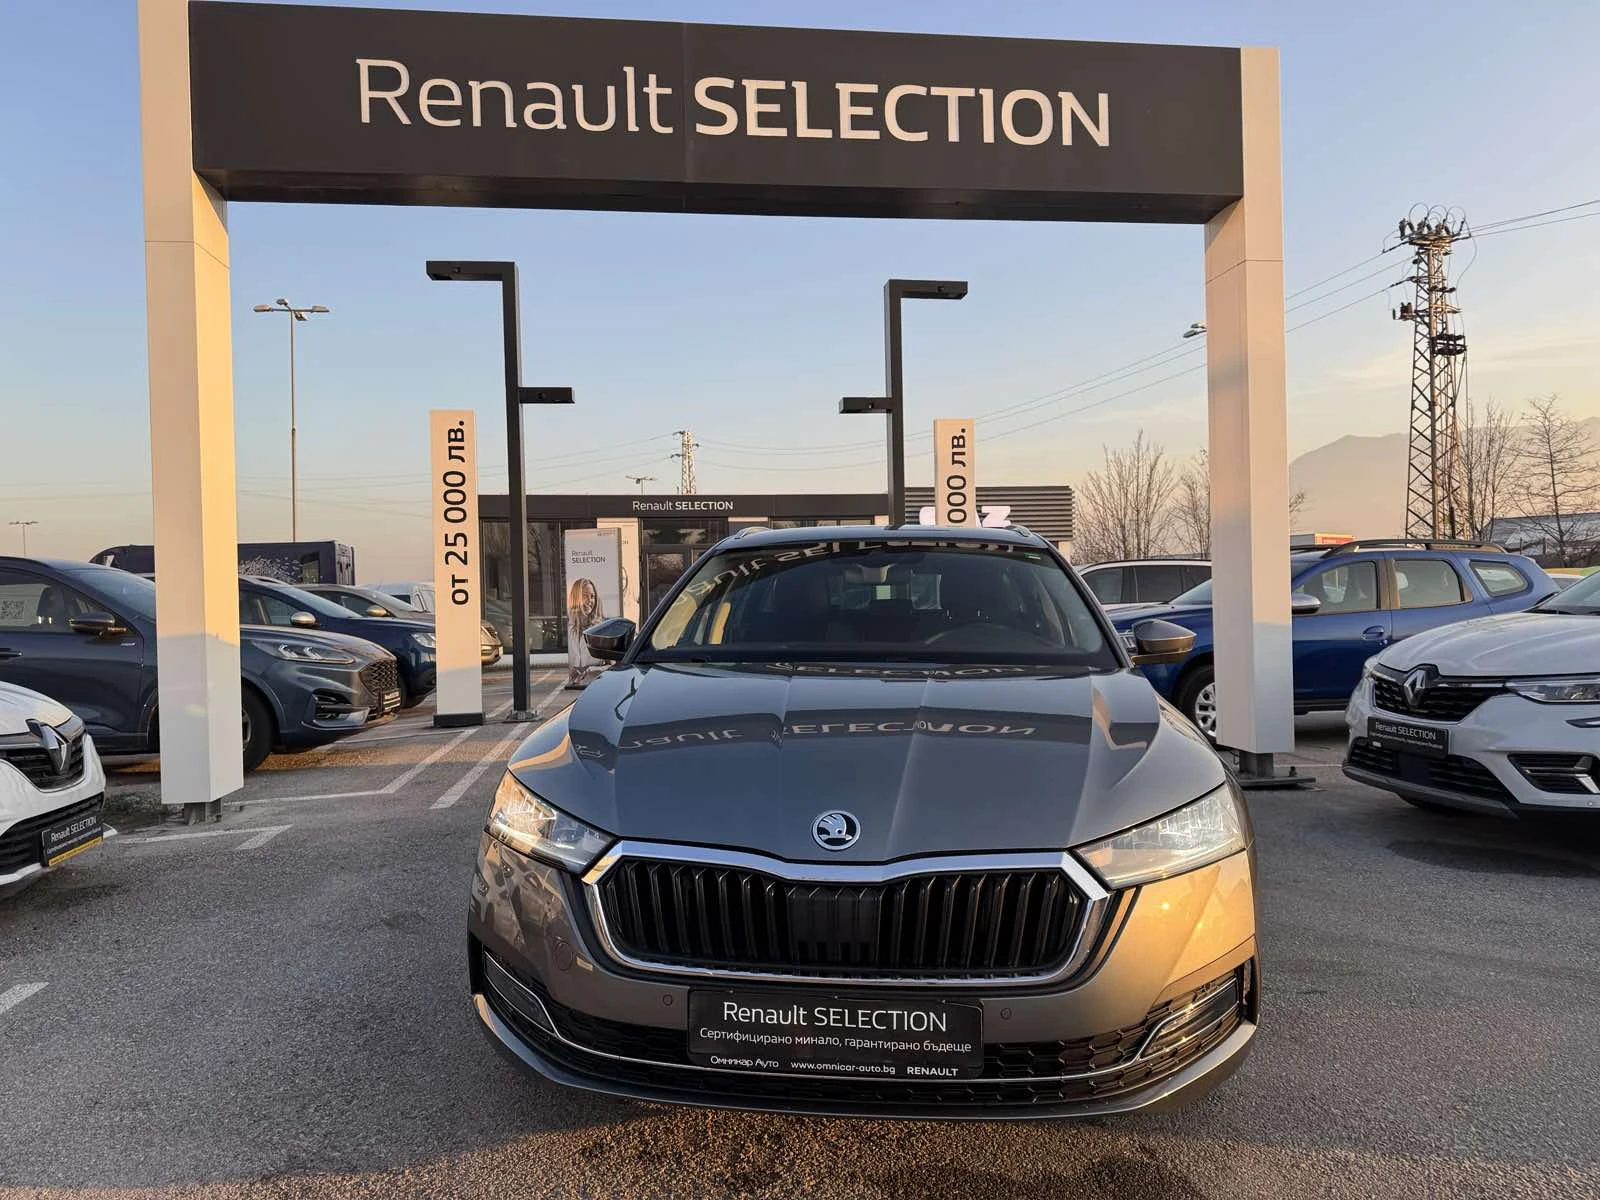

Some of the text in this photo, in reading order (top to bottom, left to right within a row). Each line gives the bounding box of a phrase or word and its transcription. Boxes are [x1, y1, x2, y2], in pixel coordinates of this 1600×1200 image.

[355, 57, 1111, 149] Renault SELECTION
[946, 428, 967, 524] 000 лв.
[442, 420, 470, 606] от 25 000 лв.
[632, 500, 734, 511] Renault SELECTION
[571, 556, 607, 564] SELECTION
[1398, 726, 1437, 741] SELECTION
[70, 816, 97, 835] SELECTION
[722, 1001, 947, 1033] Renault SELECTION
[699, 1027, 972, 1054] Сертифицирано минало, гарантирано бъдеще
[791, 1061, 896, 1075] www.omnicar-auto.bg
[907, 1065, 959, 1077] RENAULT
